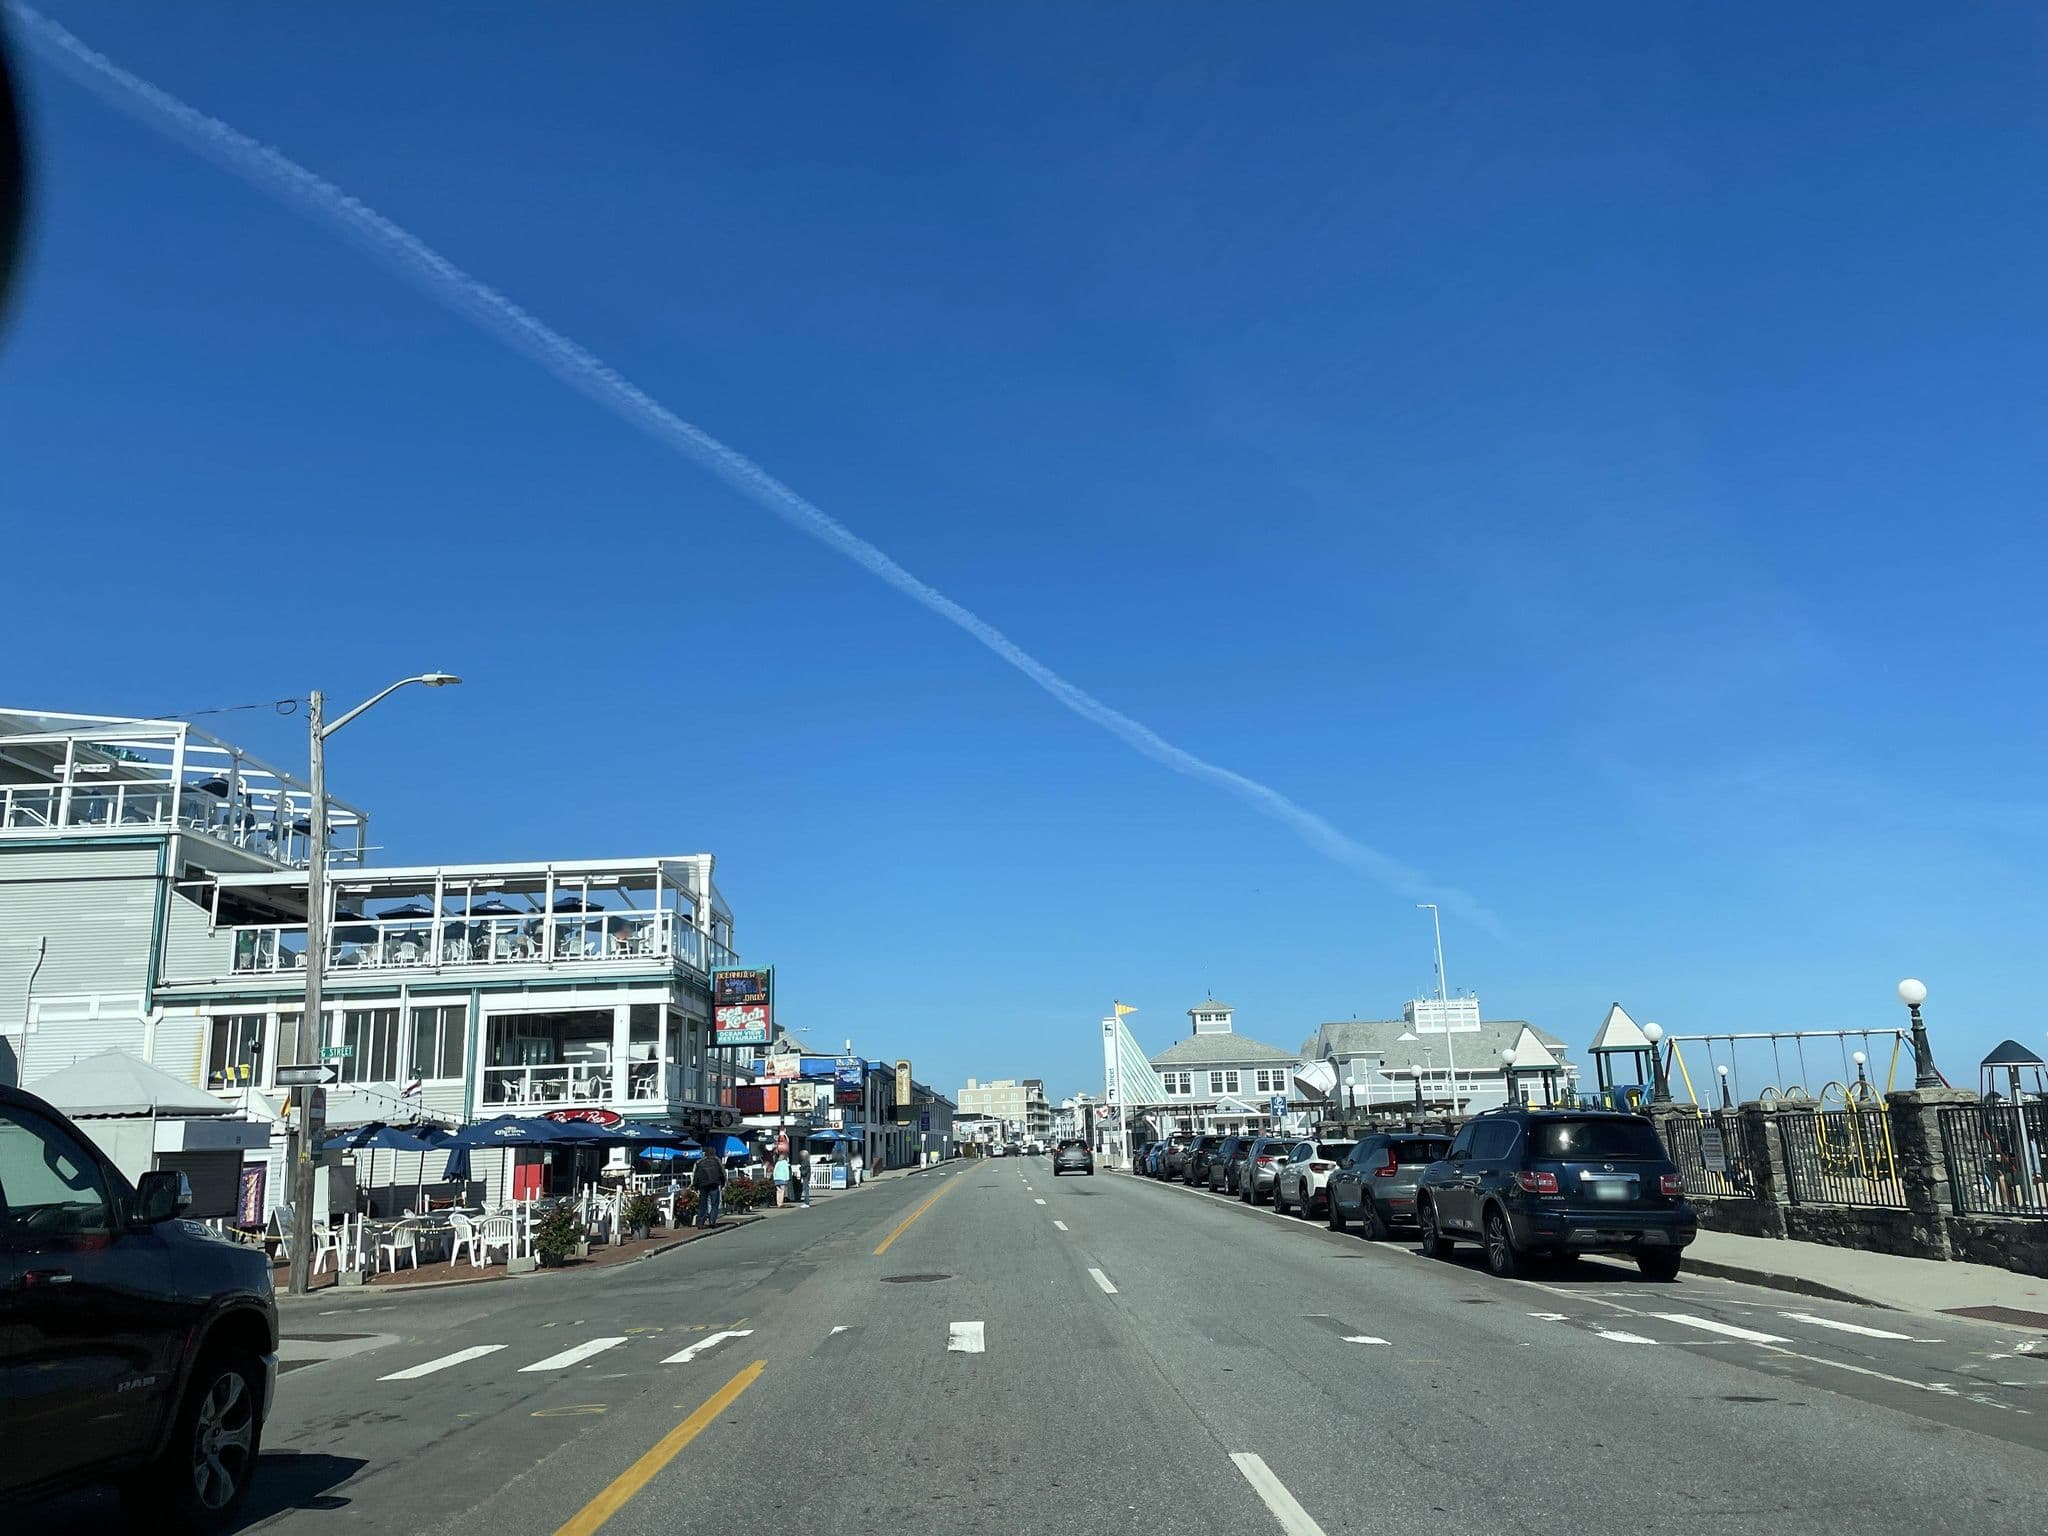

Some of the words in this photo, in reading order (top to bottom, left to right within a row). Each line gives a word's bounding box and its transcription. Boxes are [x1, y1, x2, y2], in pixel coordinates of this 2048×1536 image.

[321, 1049, 326, 1057] G
[330, 1047, 352, 1056] STREET
[1109, 1089, 1115, 1100] F
